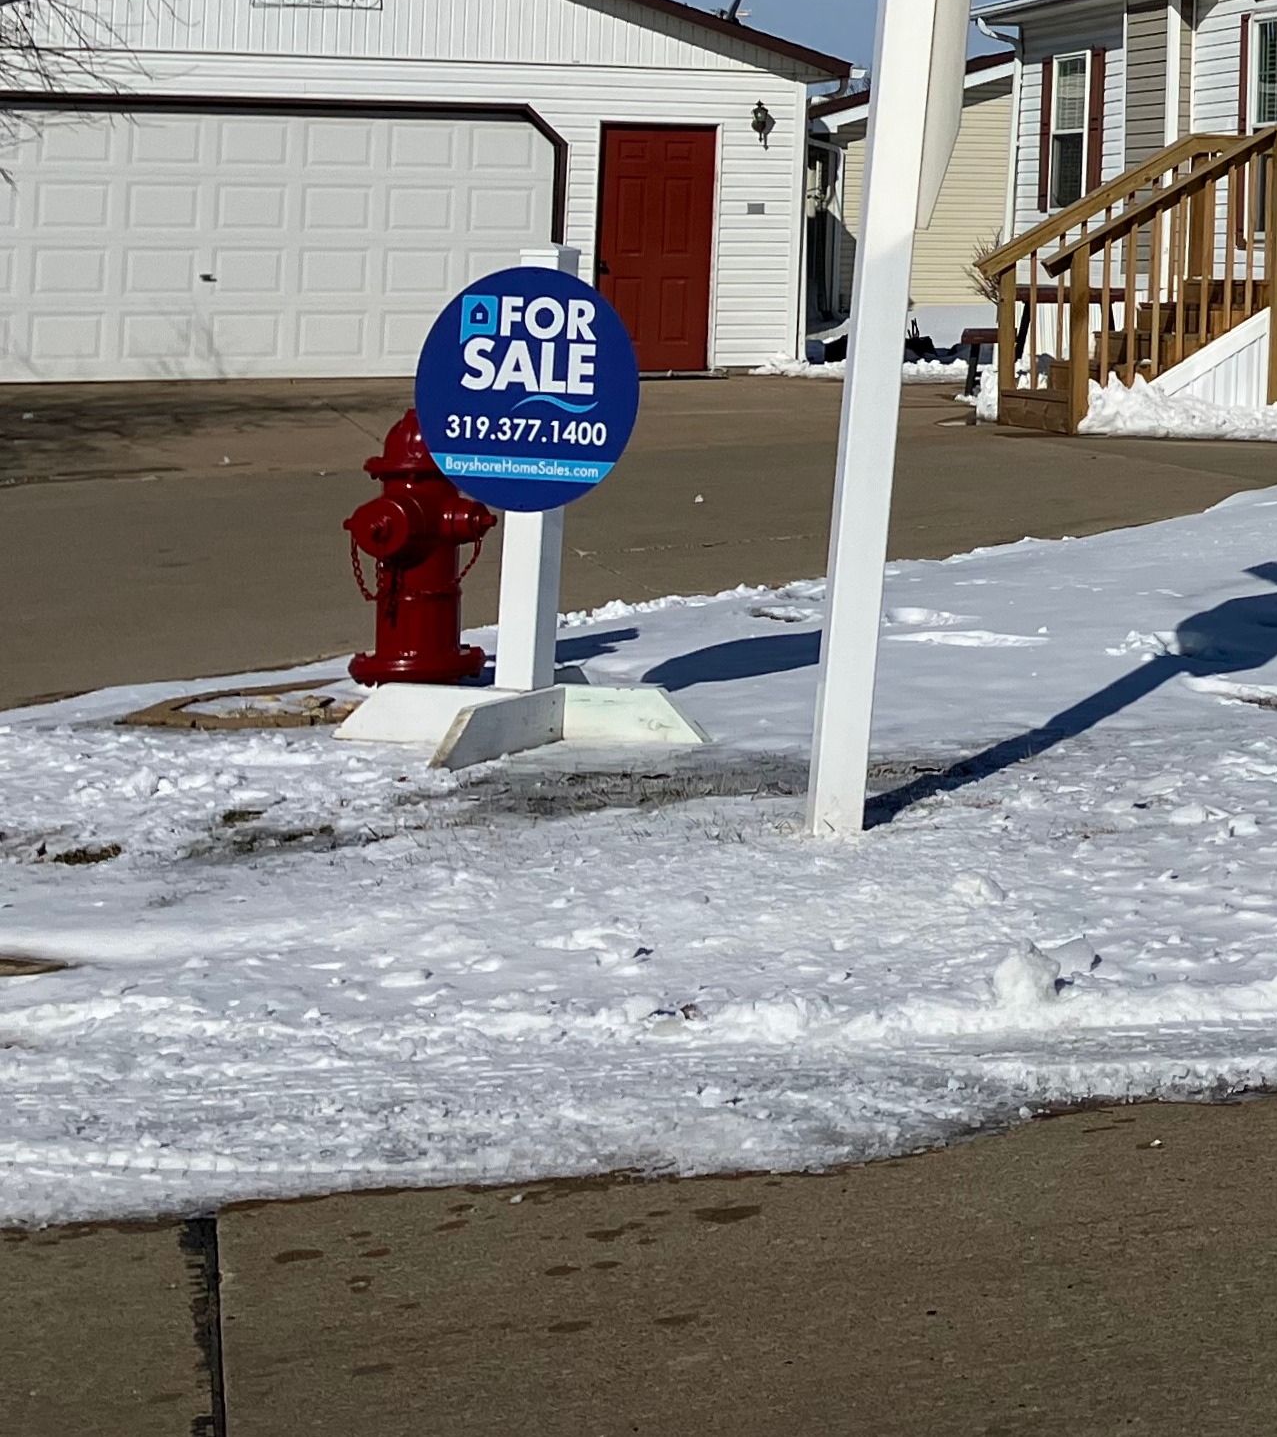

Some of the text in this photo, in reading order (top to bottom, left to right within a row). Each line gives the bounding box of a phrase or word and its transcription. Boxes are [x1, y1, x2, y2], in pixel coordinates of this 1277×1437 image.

[500, 296, 597, 341] FOR
[460, 337, 597, 395] SALE
[445, 414, 607, 446] 319.377.1400
[445, 456, 599, 478] BayshoreHomeSales.com
